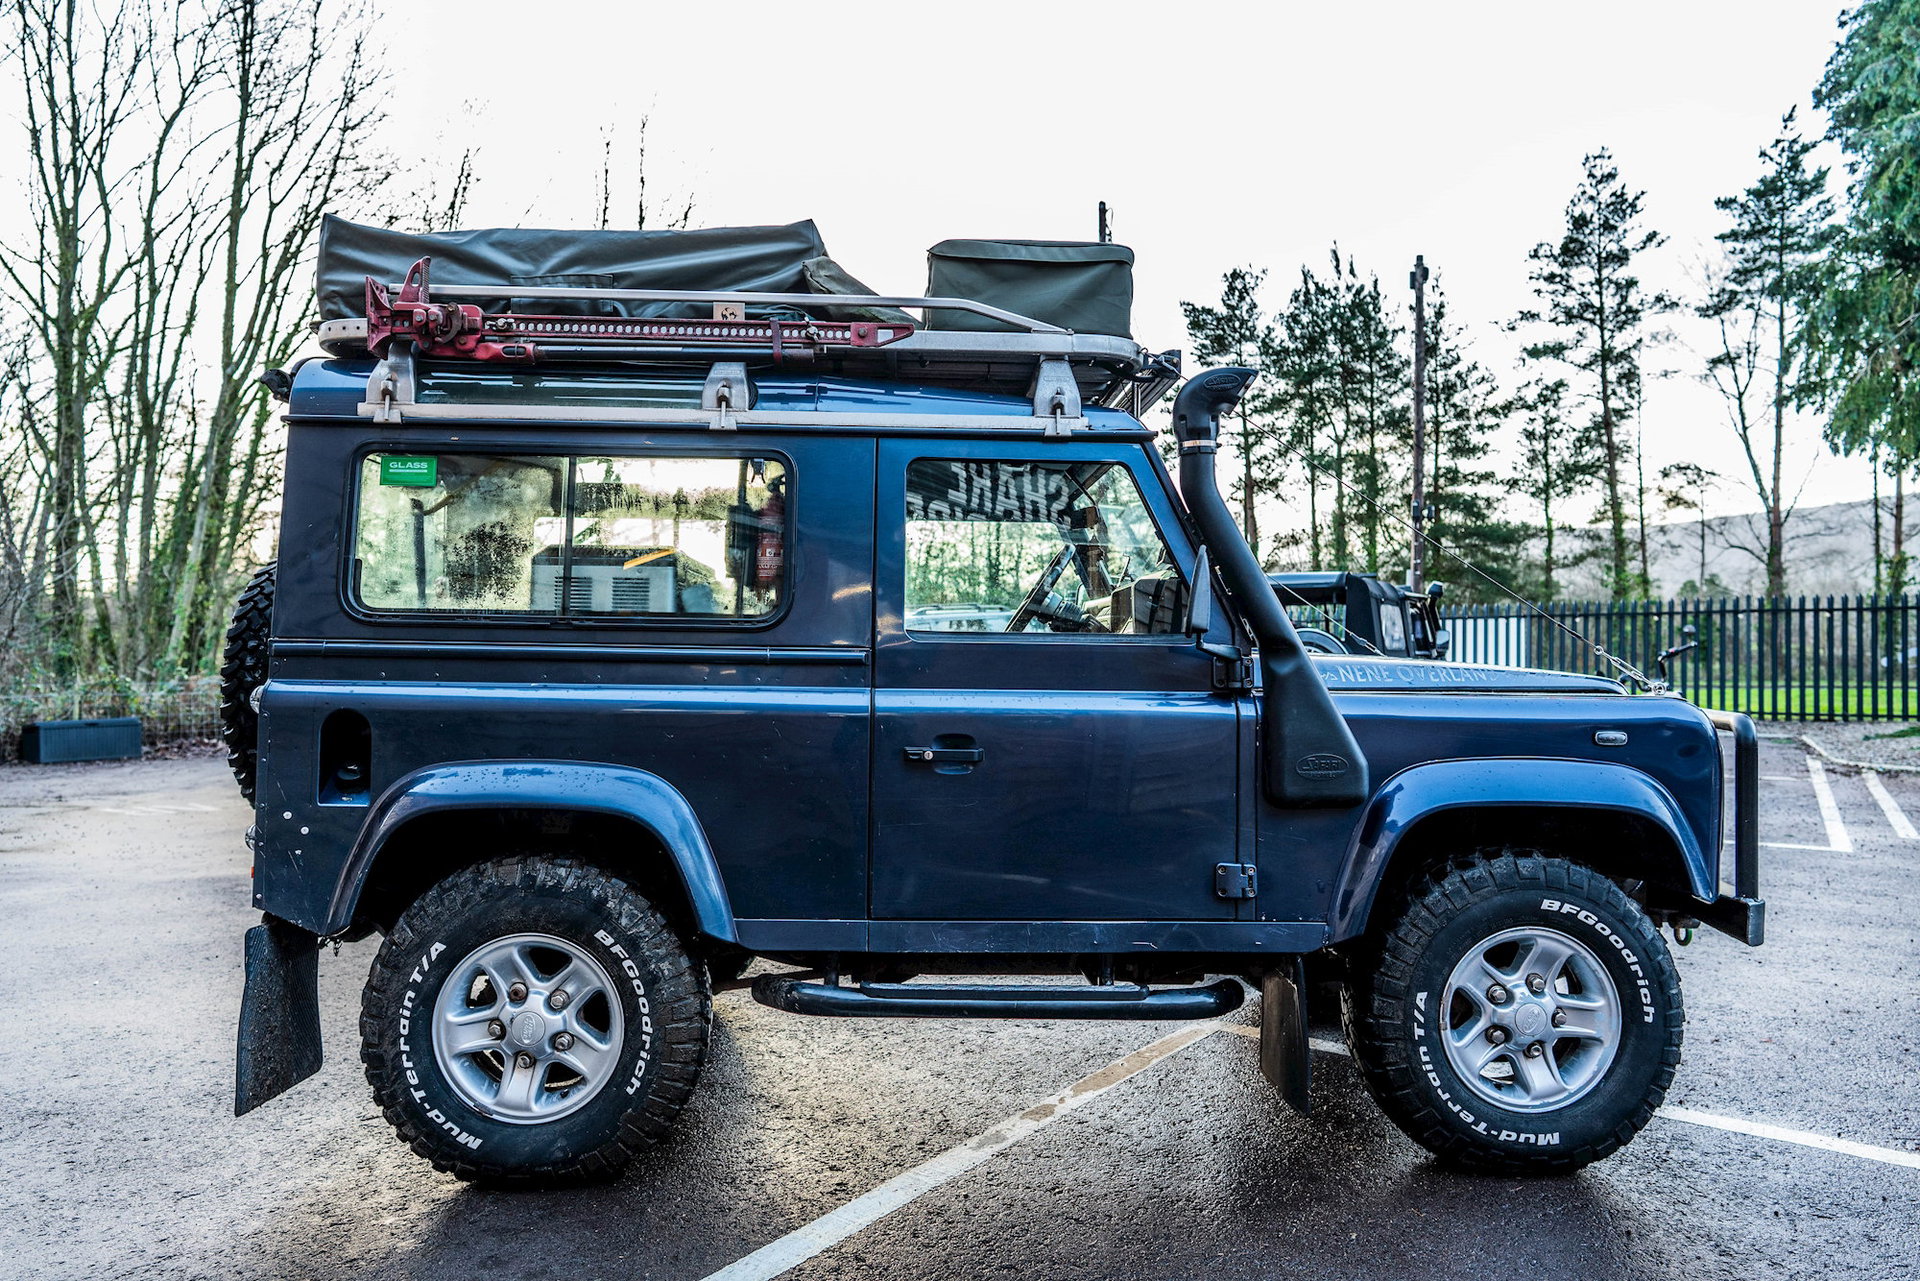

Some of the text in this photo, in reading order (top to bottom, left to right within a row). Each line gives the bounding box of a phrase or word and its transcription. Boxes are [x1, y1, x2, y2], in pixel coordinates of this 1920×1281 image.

[389, 461, 428, 469] GLASS
[1336, 664, 1393, 682] NENE
[410, 941, 447, 984] T/A
[1540, 898, 1657, 1024] BFGoodrich
[594, 929, 654, 1096] BFGoodrich
[1413, 991, 1428, 1041] T/A
